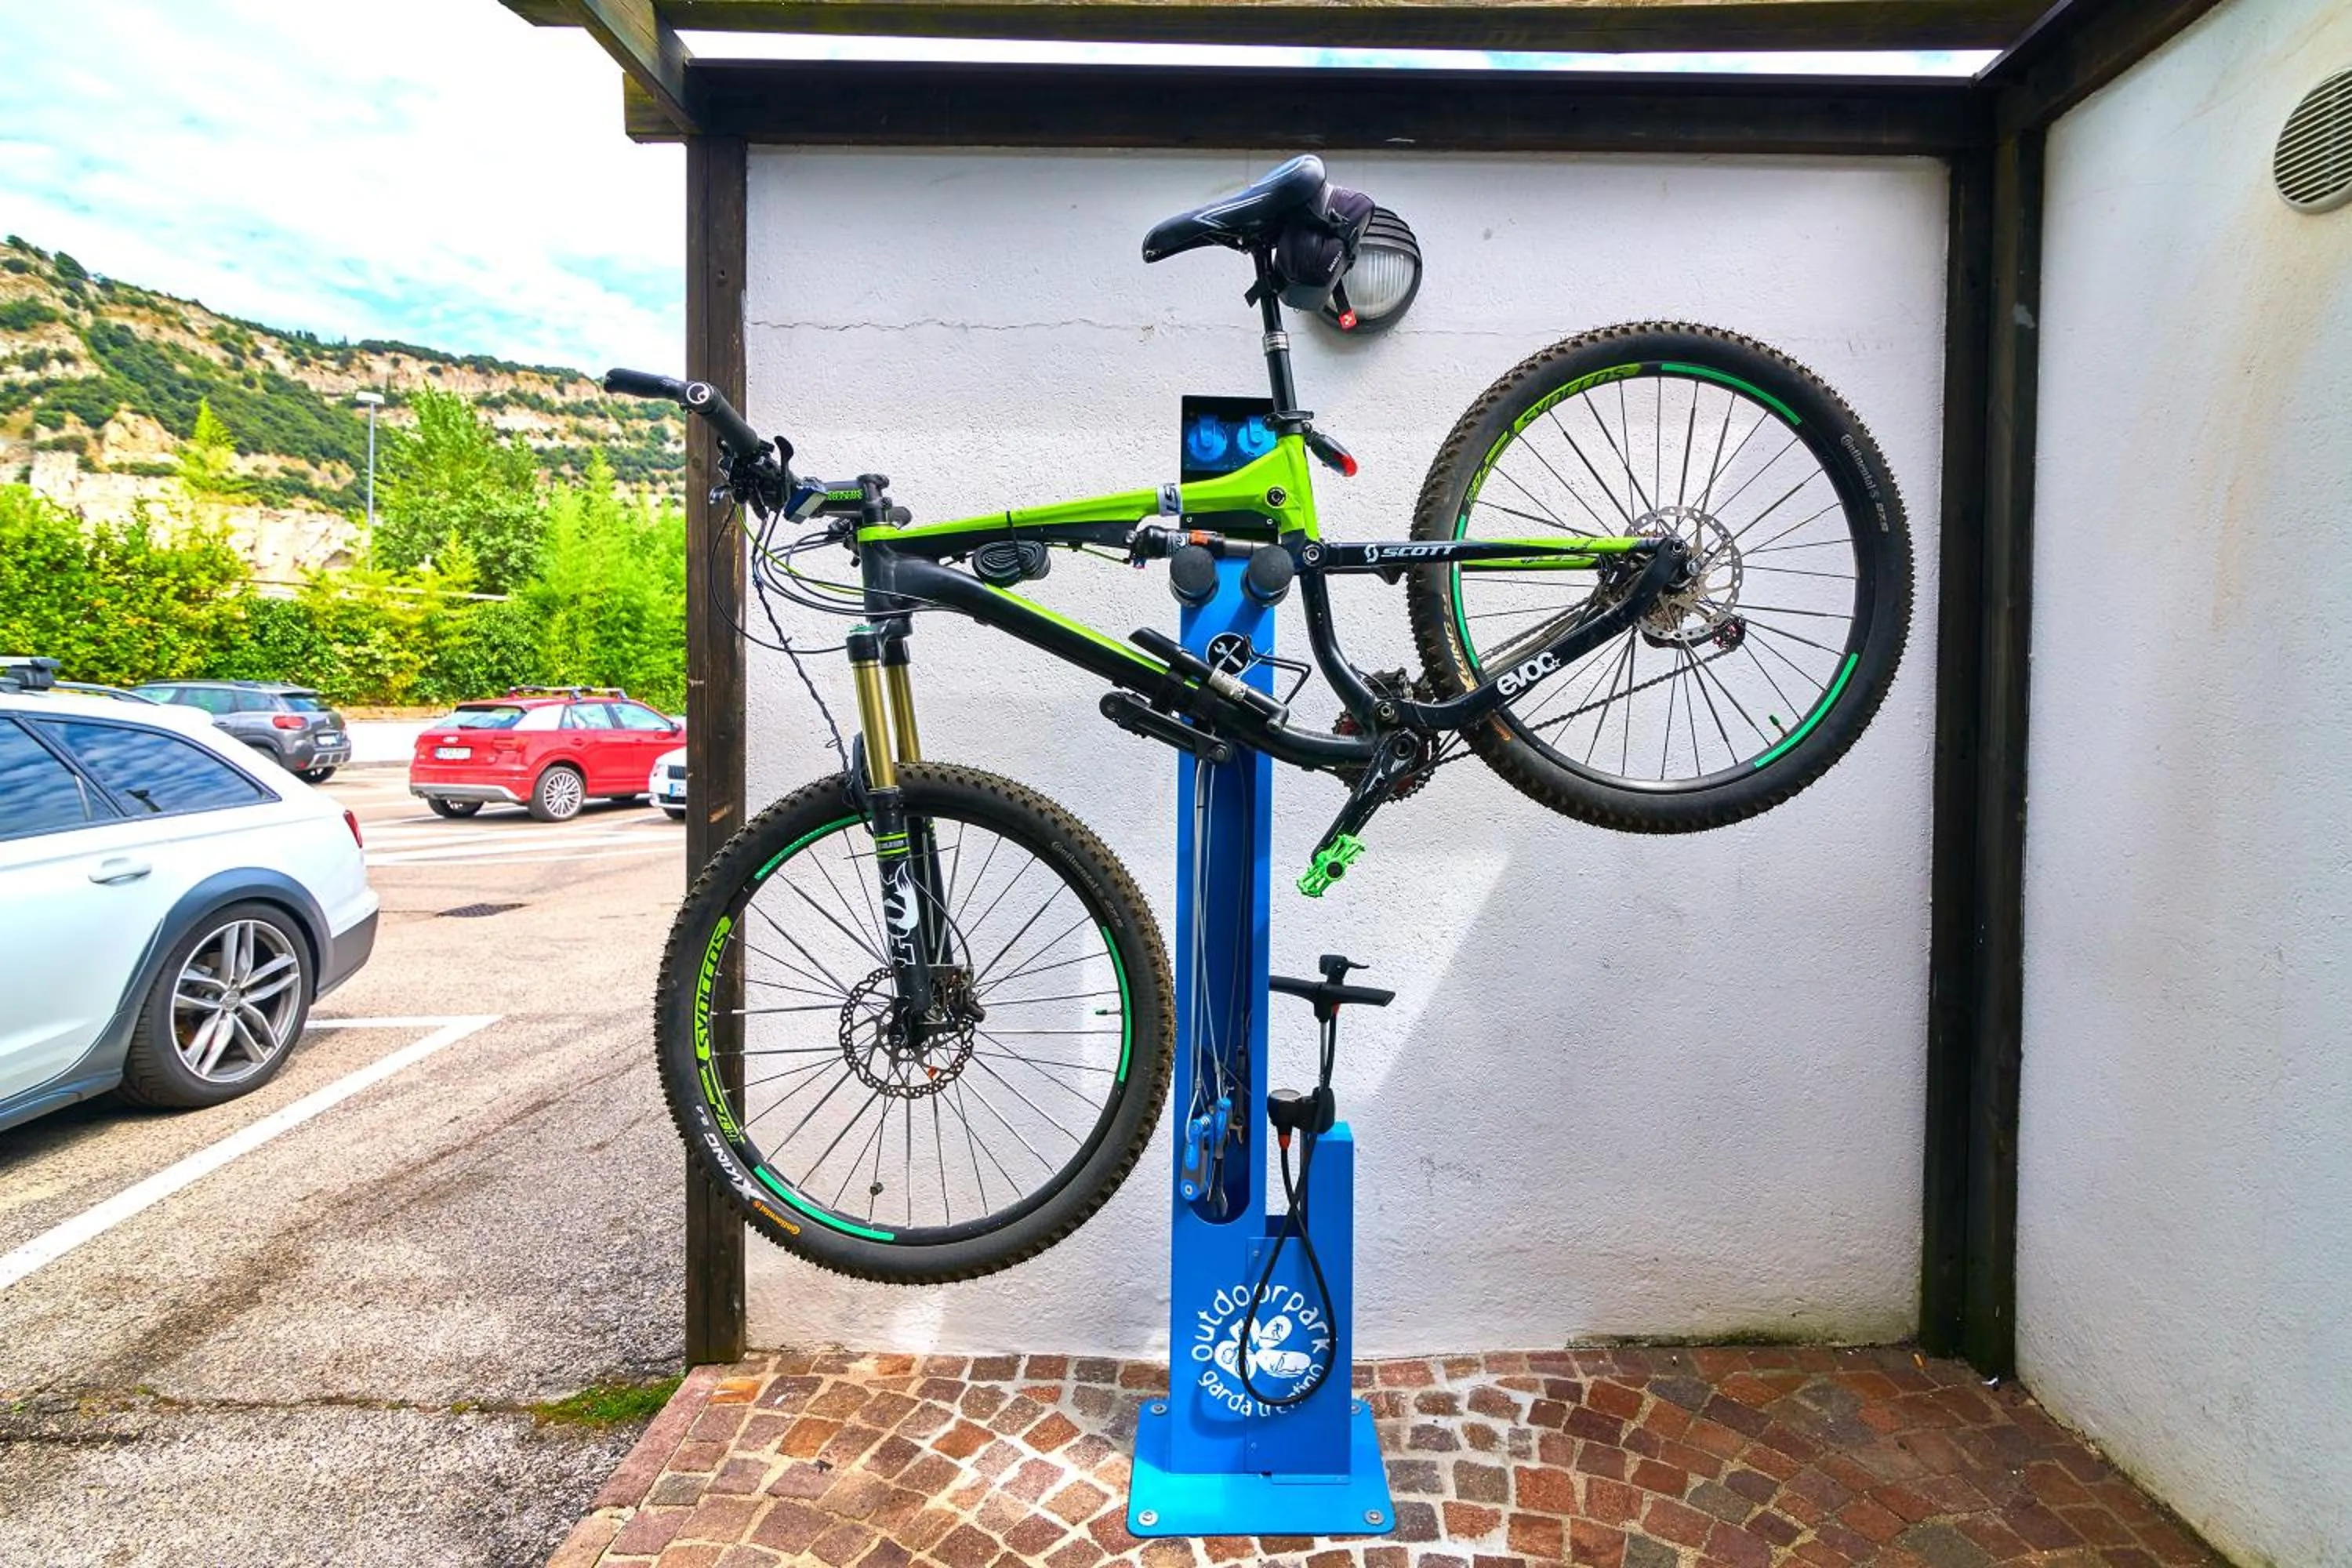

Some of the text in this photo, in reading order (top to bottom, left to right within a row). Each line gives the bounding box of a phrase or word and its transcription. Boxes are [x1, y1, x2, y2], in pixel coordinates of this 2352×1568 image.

[1381, 544, 1457, 558] SCOTT
[1496, 651, 1556, 696] evoc
[1197, 1370, 1252, 1417] garda
